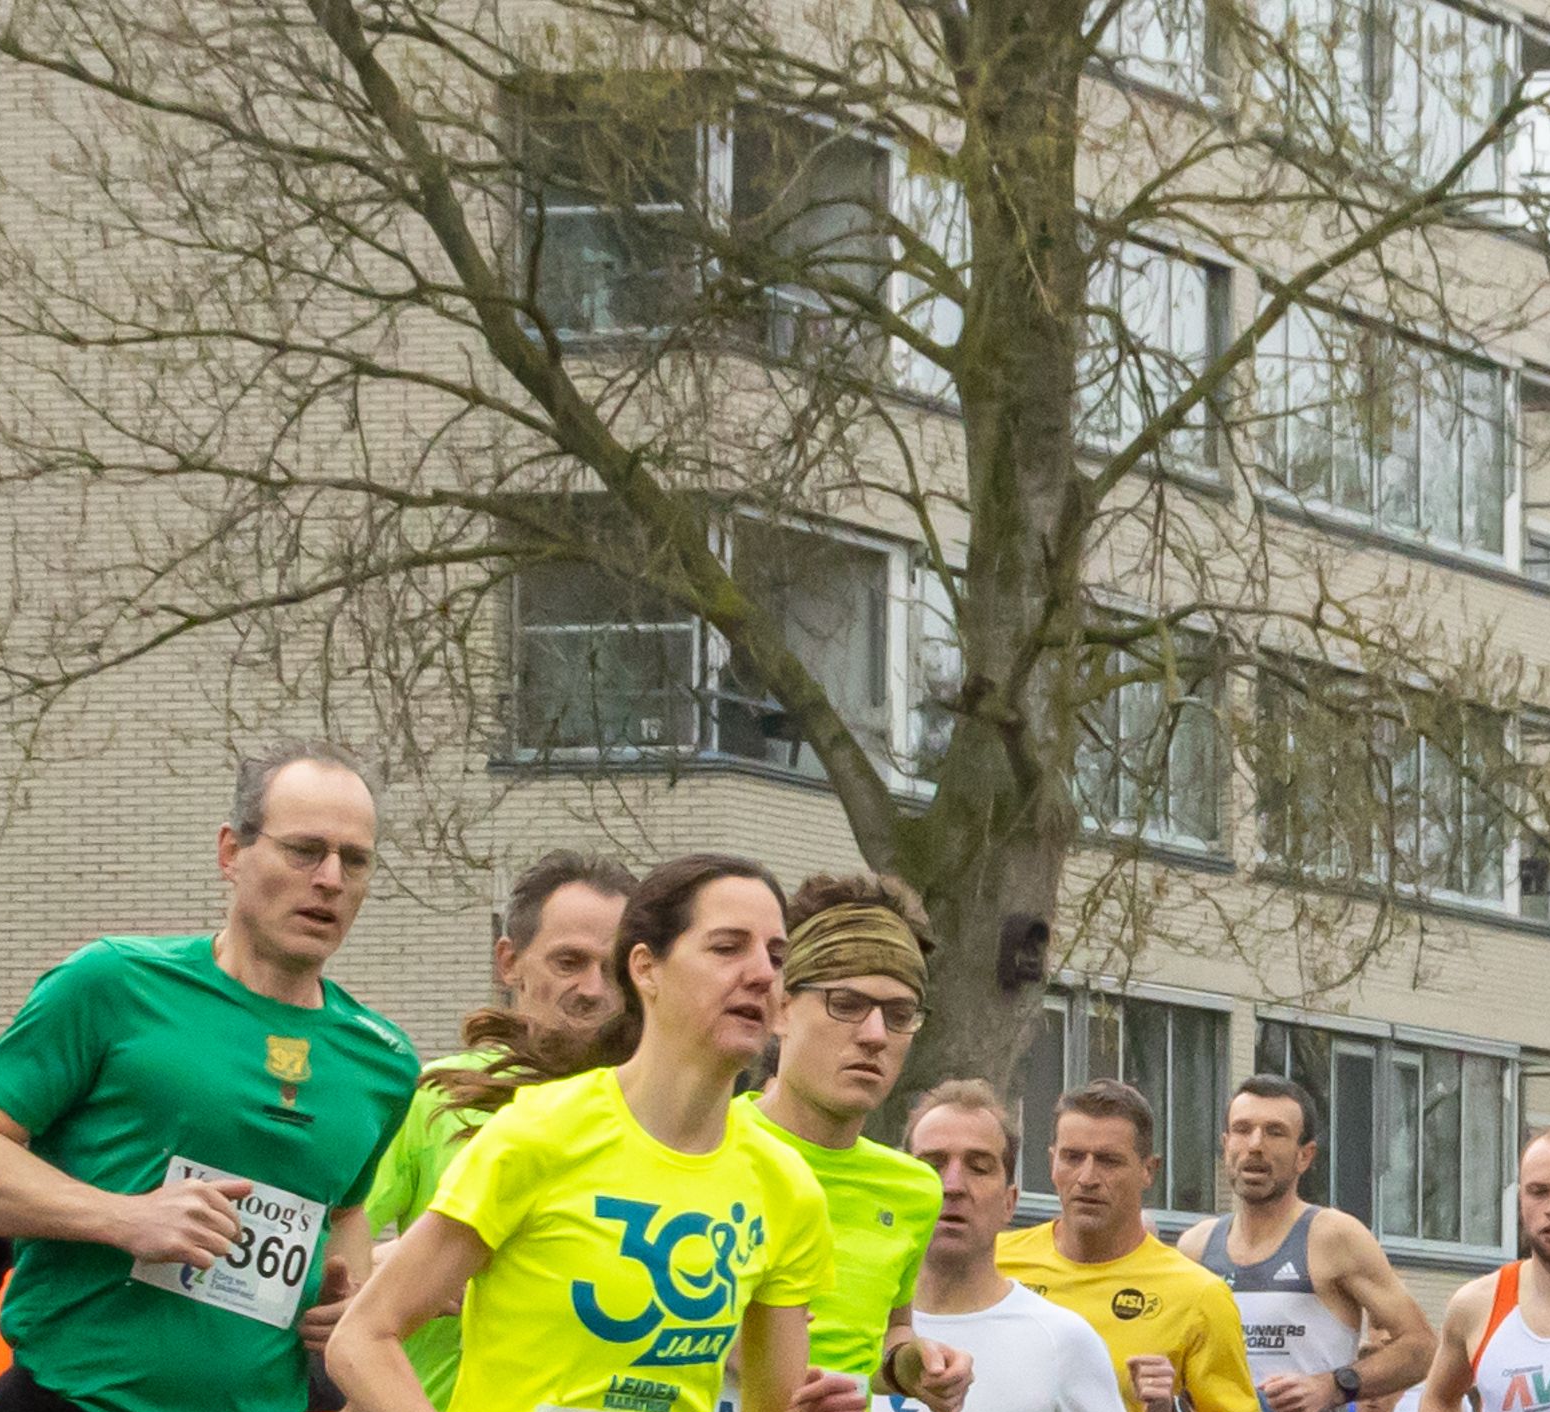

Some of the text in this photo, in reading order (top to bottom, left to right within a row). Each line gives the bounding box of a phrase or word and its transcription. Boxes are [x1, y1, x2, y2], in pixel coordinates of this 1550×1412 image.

[225, 1226, 308, 1288] 360
[571, 1195, 729, 1343] 30
[656, 1334, 727, 1358] JAAR
[1245, 1336, 1286, 1349] ORLD
[609, 1375, 681, 1402] LEIDEN
